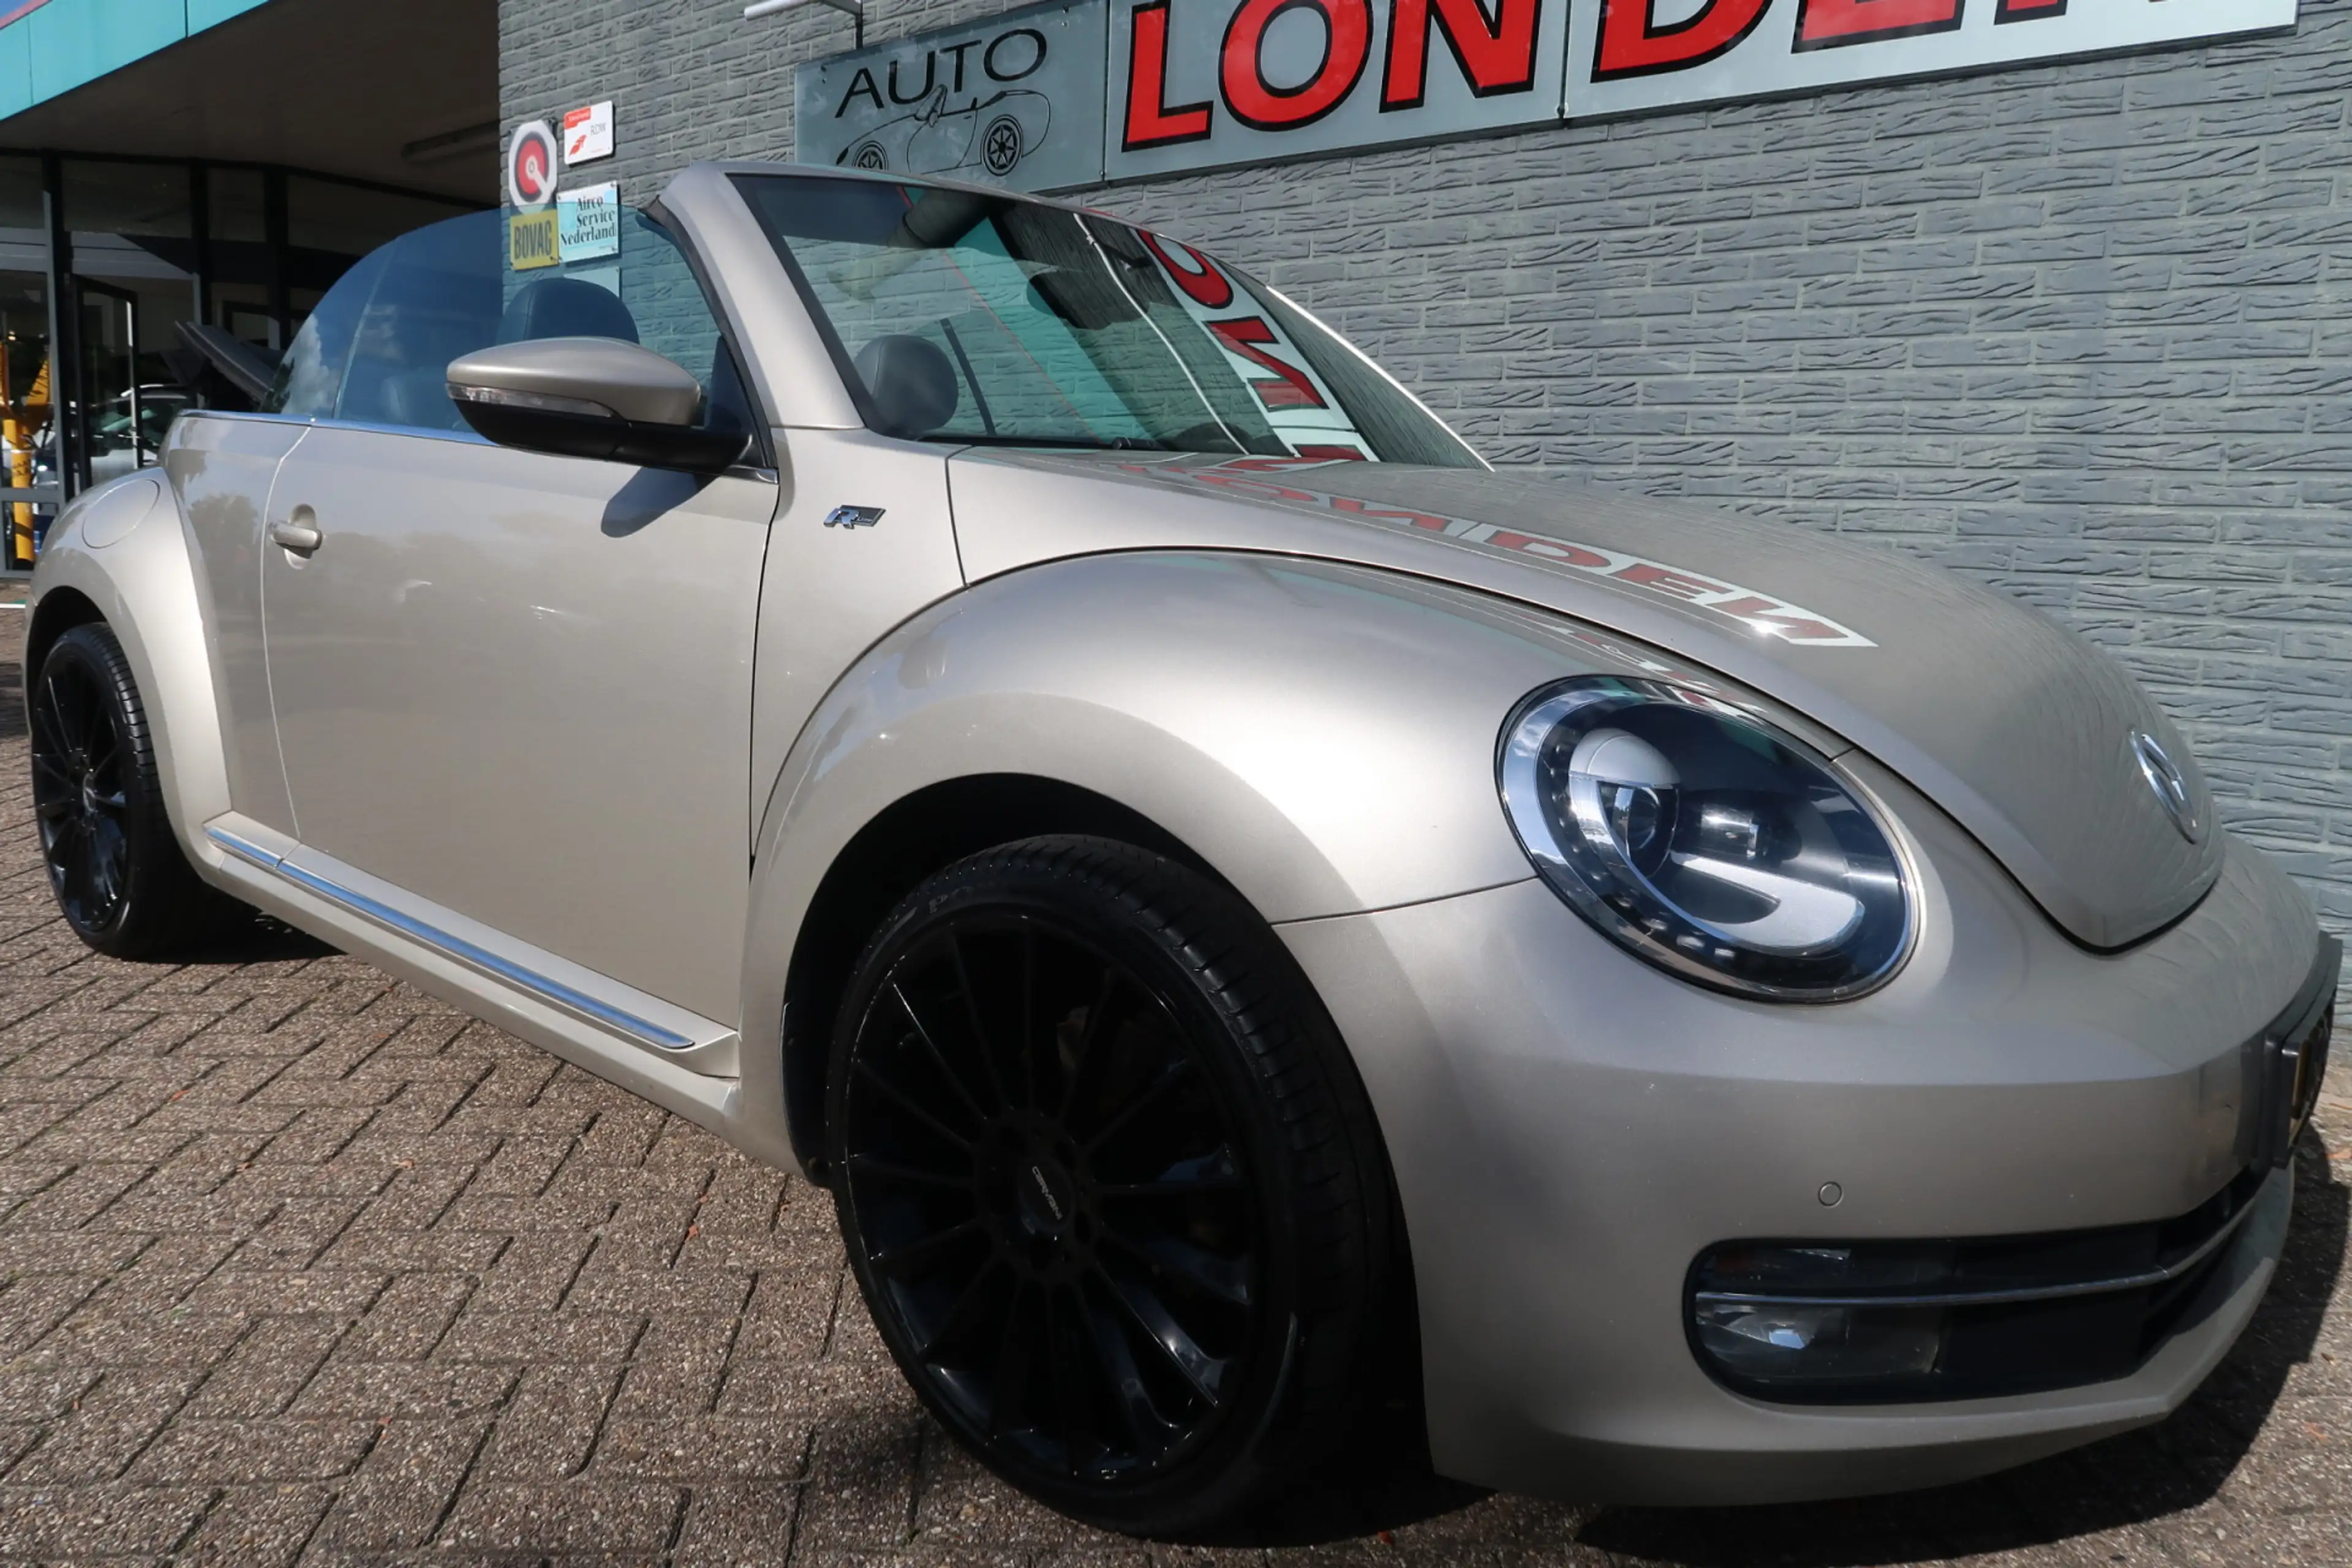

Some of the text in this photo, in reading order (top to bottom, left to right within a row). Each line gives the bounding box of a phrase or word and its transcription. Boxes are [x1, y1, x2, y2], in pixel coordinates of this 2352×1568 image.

[834, 28, 1047, 118] AUTO
[576, 195, 603, 211] Airco
[576, 208, 615, 228] Service
[514, 219, 552, 260] BOVAG
[560, 222, 617, 246] Nederland
